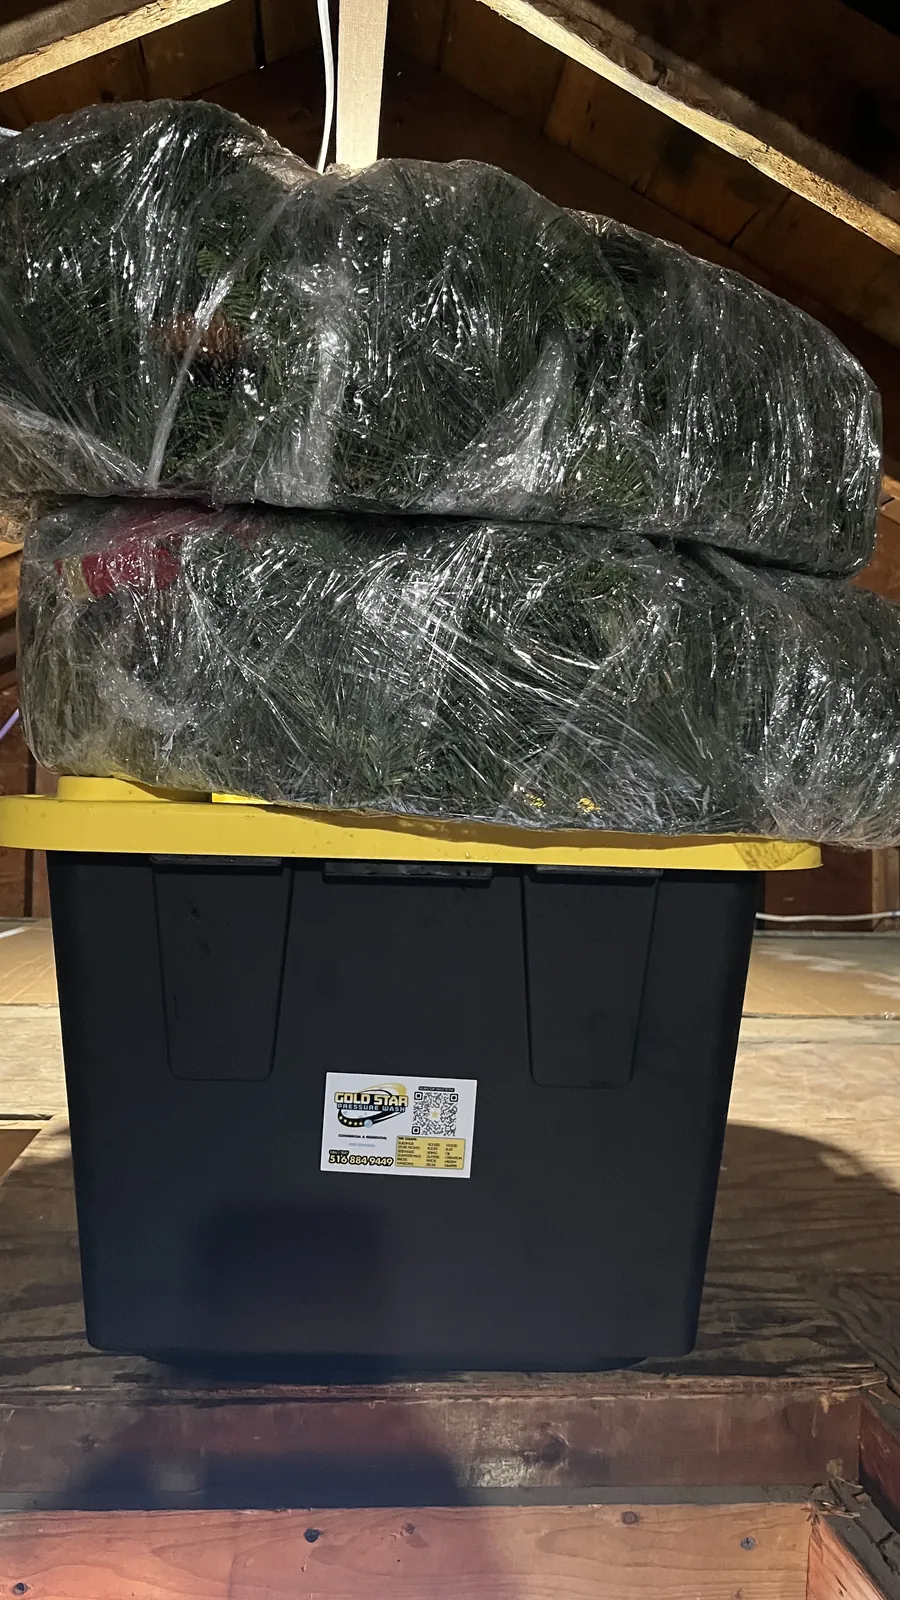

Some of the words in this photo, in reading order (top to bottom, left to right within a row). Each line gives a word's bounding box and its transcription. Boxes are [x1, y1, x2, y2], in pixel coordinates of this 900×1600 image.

[334, 1092, 370, 1104] GOLD
[374, 1095, 408, 1106] STAR
[329, 1154, 348, 1163] 516
[349, 1155, 368, 1164] 884
[368, 1156, 394, 1166] 9449
